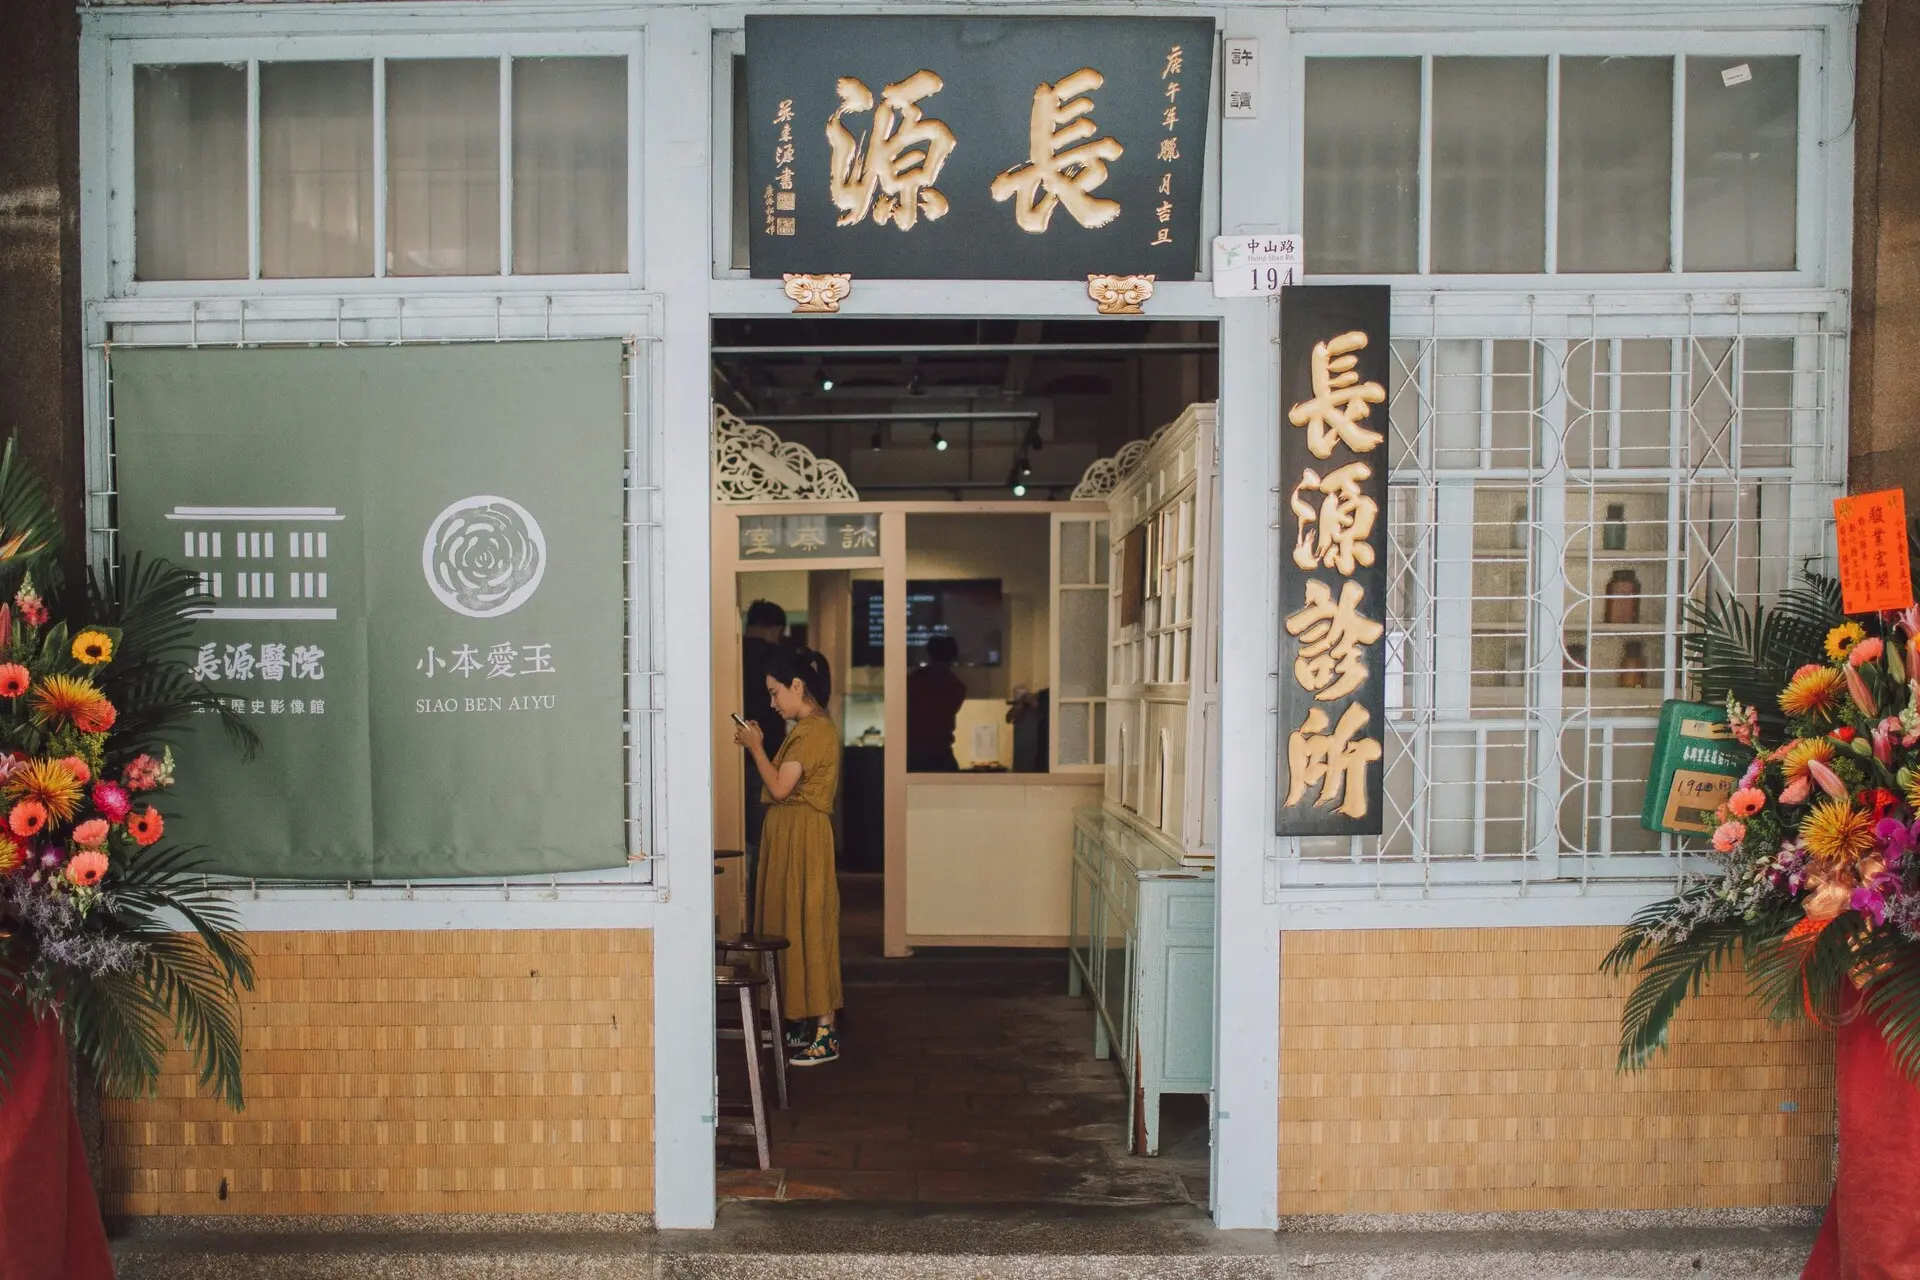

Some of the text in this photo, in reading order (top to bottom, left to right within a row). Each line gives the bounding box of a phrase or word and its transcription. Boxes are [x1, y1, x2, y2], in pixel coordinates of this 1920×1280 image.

[1247, 238, 1295, 254] 中山路
[1251, 267, 1295, 290] 194
[1286, 331, 1385, 820] 長源診所
[188, 642, 325, 681] 長源醫院
[416, 641, 556, 679] 小本愛玉
[416, 695, 557, 713] SIAO BEN AIYU
